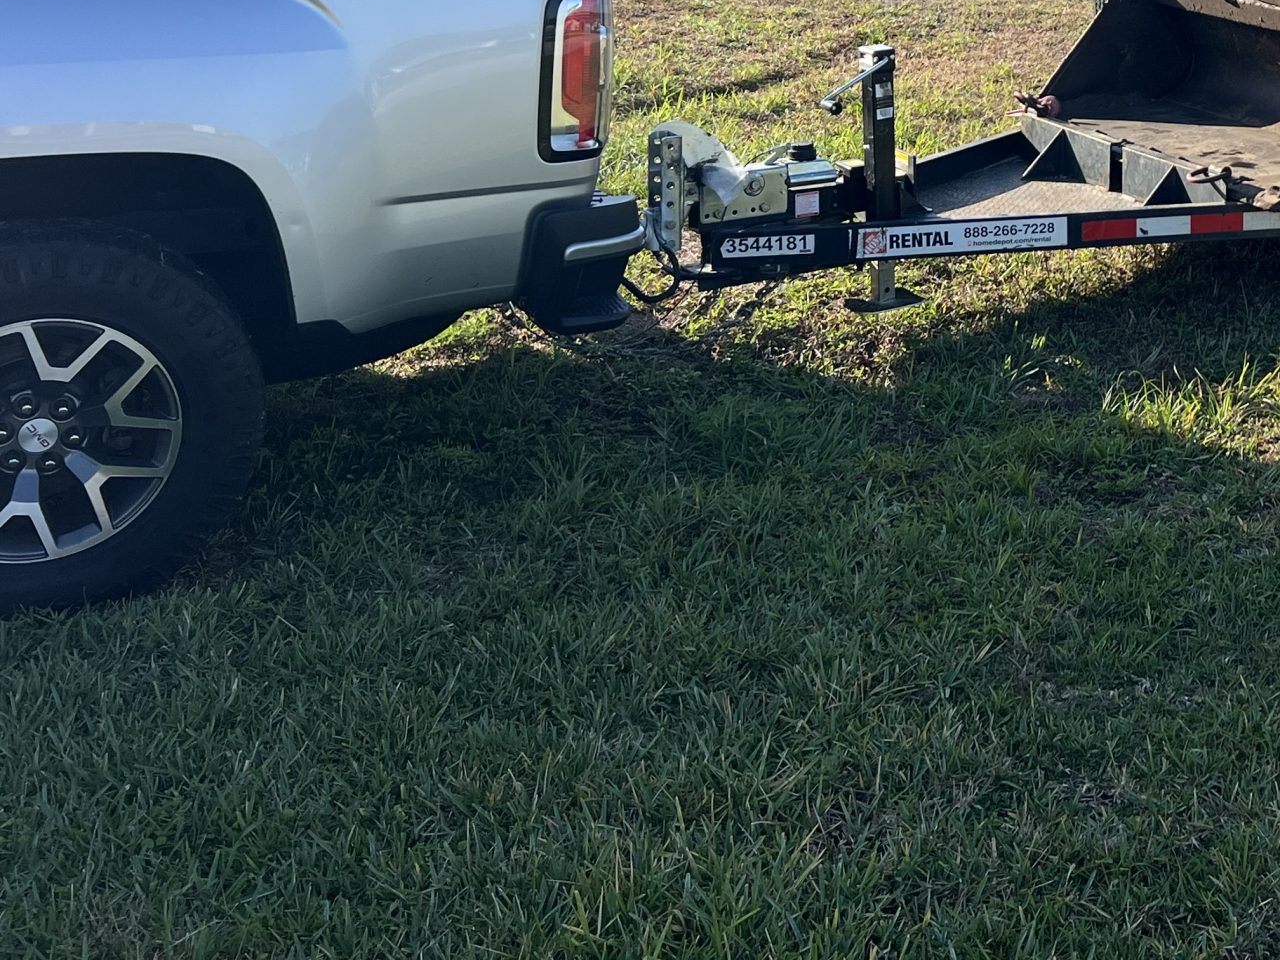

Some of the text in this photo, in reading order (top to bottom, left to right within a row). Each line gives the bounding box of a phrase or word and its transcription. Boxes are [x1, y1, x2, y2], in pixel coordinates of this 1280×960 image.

[964, 223, 1055, 238] 888-266-7228
[725, 236, 809, 253] 3544181
[889, 231, 953, 249] RENTAL
[973, 236, 1051, 246] homedepot.com/rental
[26, 423, 50, 447] GMC
